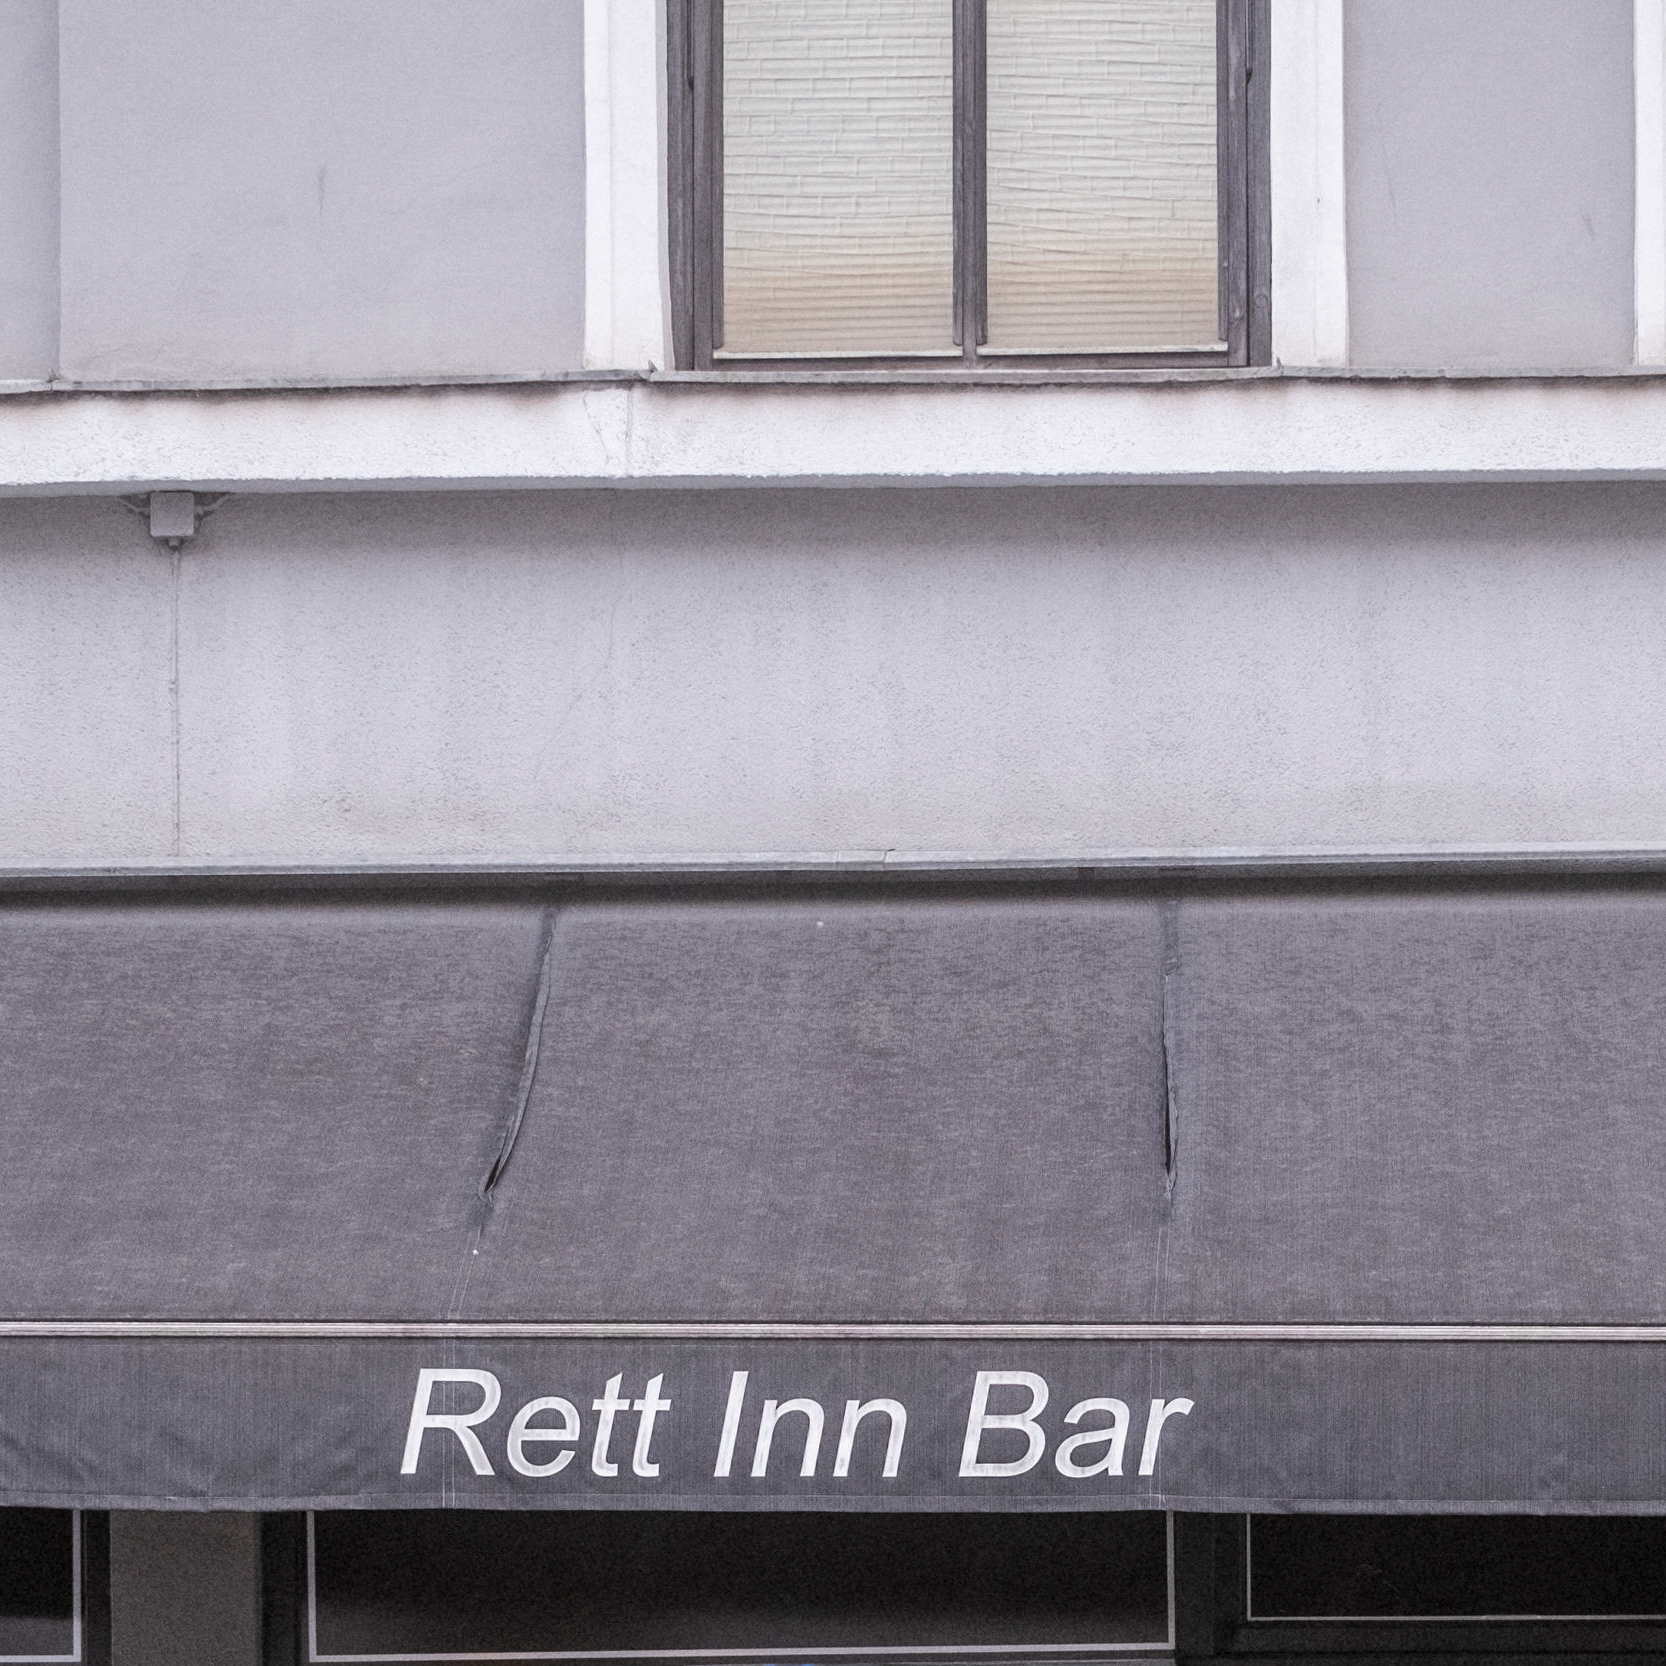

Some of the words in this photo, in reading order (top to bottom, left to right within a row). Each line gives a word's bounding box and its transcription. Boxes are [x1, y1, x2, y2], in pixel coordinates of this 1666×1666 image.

[401, 1368, 671, 1477] Rett
[714, 1371, 907, 1477] Inn
[959, 1371, 1194, 1478] Bar
